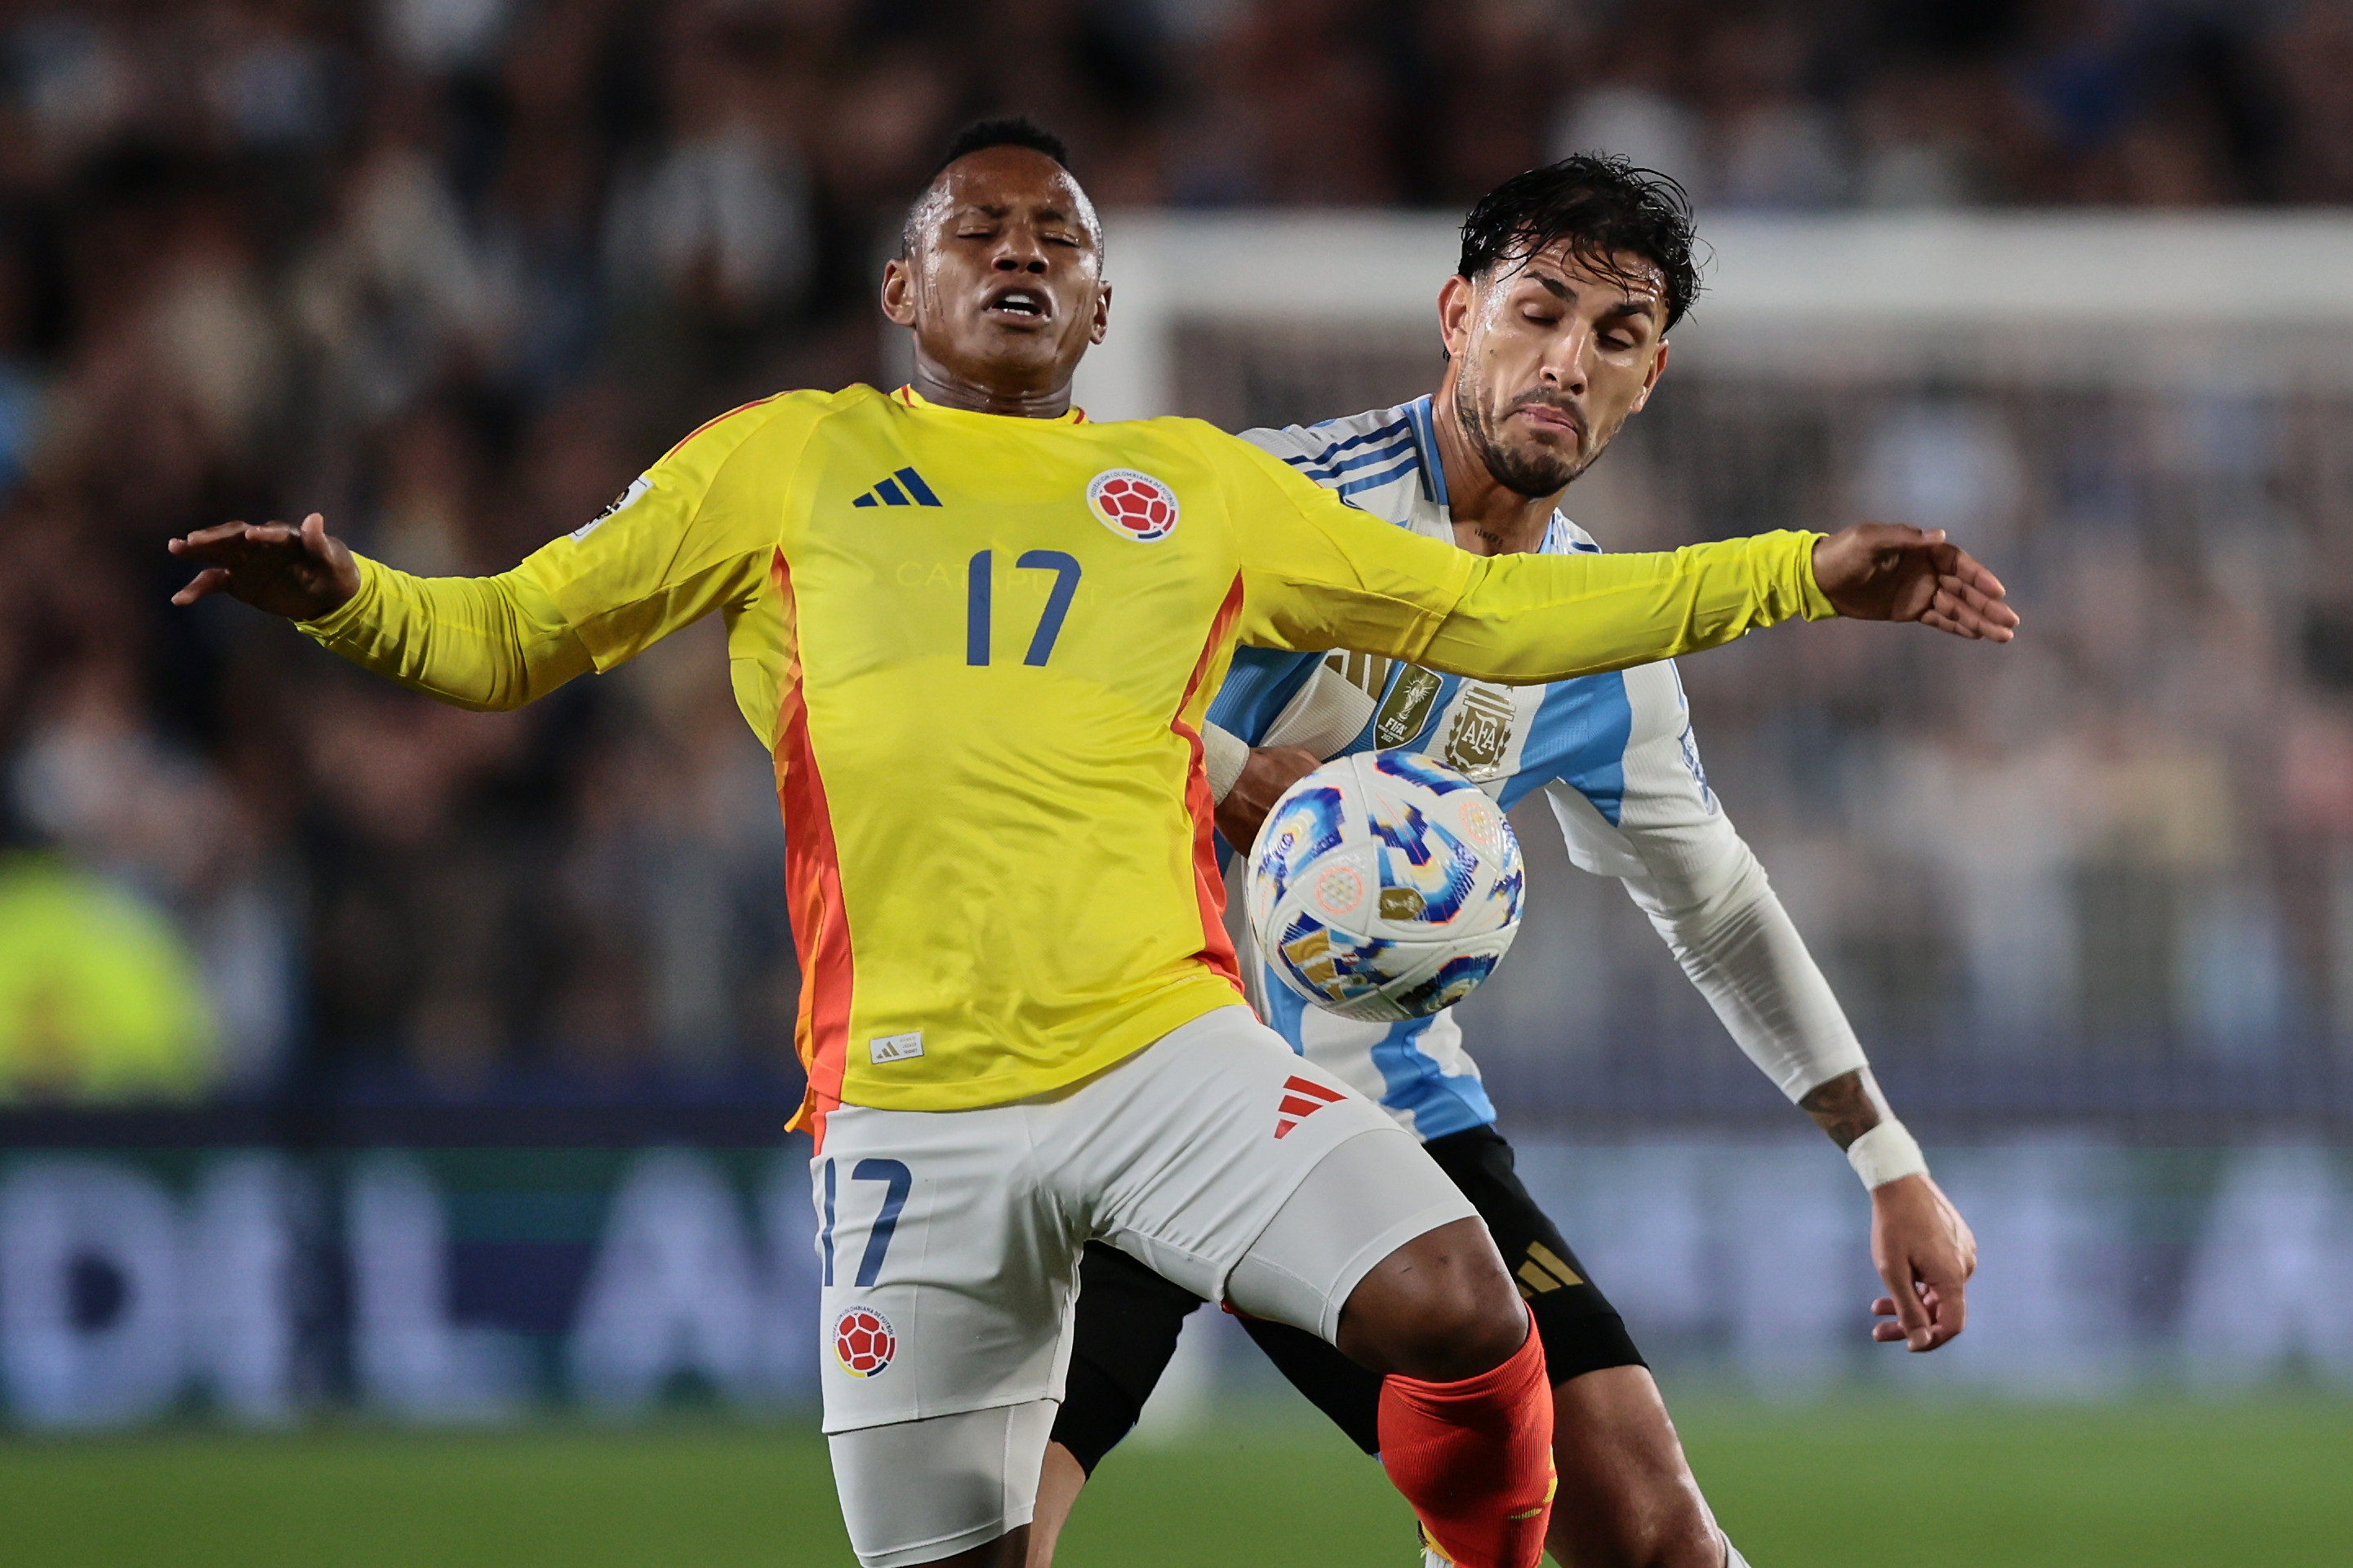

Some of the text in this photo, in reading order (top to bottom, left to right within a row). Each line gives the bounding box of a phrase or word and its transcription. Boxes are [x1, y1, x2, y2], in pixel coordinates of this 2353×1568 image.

[897, 563, 1101, 606] CATPUT
[967, 549, 1082, 666] 17
[1385, 717, 1405, 735] FIFA
[1461, 710, 1498, 755] AFA
[821, 1157, 913, 1287] 17
